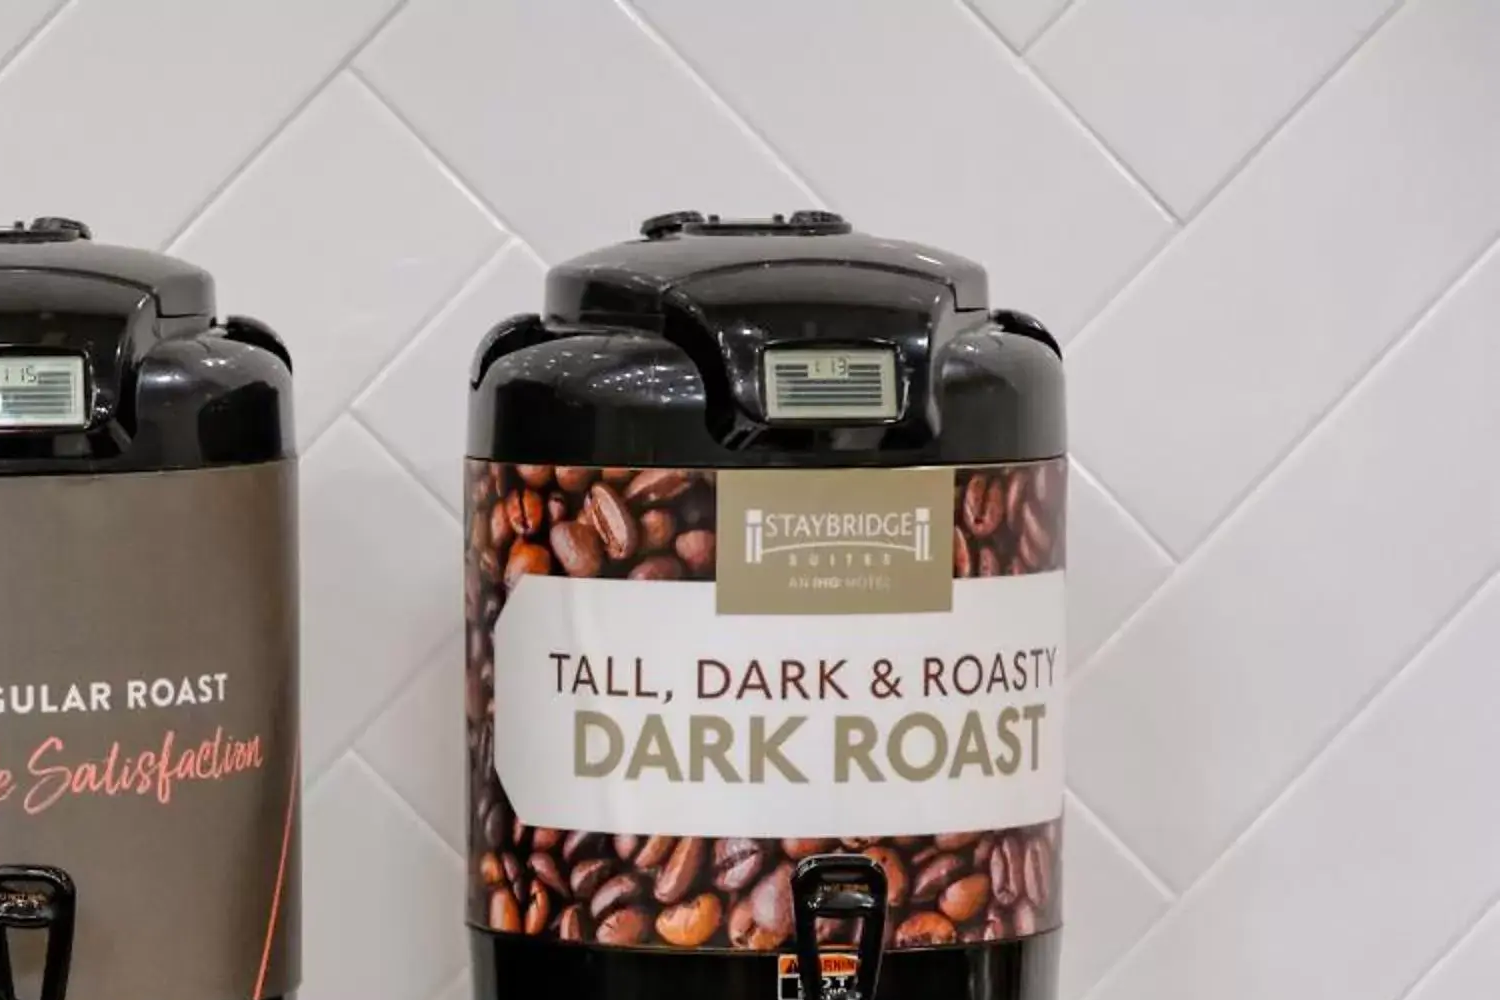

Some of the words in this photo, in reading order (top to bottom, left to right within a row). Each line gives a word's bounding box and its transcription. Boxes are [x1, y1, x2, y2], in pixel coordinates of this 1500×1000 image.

[765, 512, 912, 538] STAYBRIDGE
[788, 552, 892, 567] SUITES
[127, 672, 229, 710] ROAST
[548, 653, 673, 704] TALL,
[697, 659, 849, 701] DARK
[871, 657, 903, 700] &
[923, 646, 1057, 698] ROASTY
[573, 709, 810, 784] DARK
[833, 704, 1047, 784] ROAST
[22, 725, 264, 815] Satisfaction
